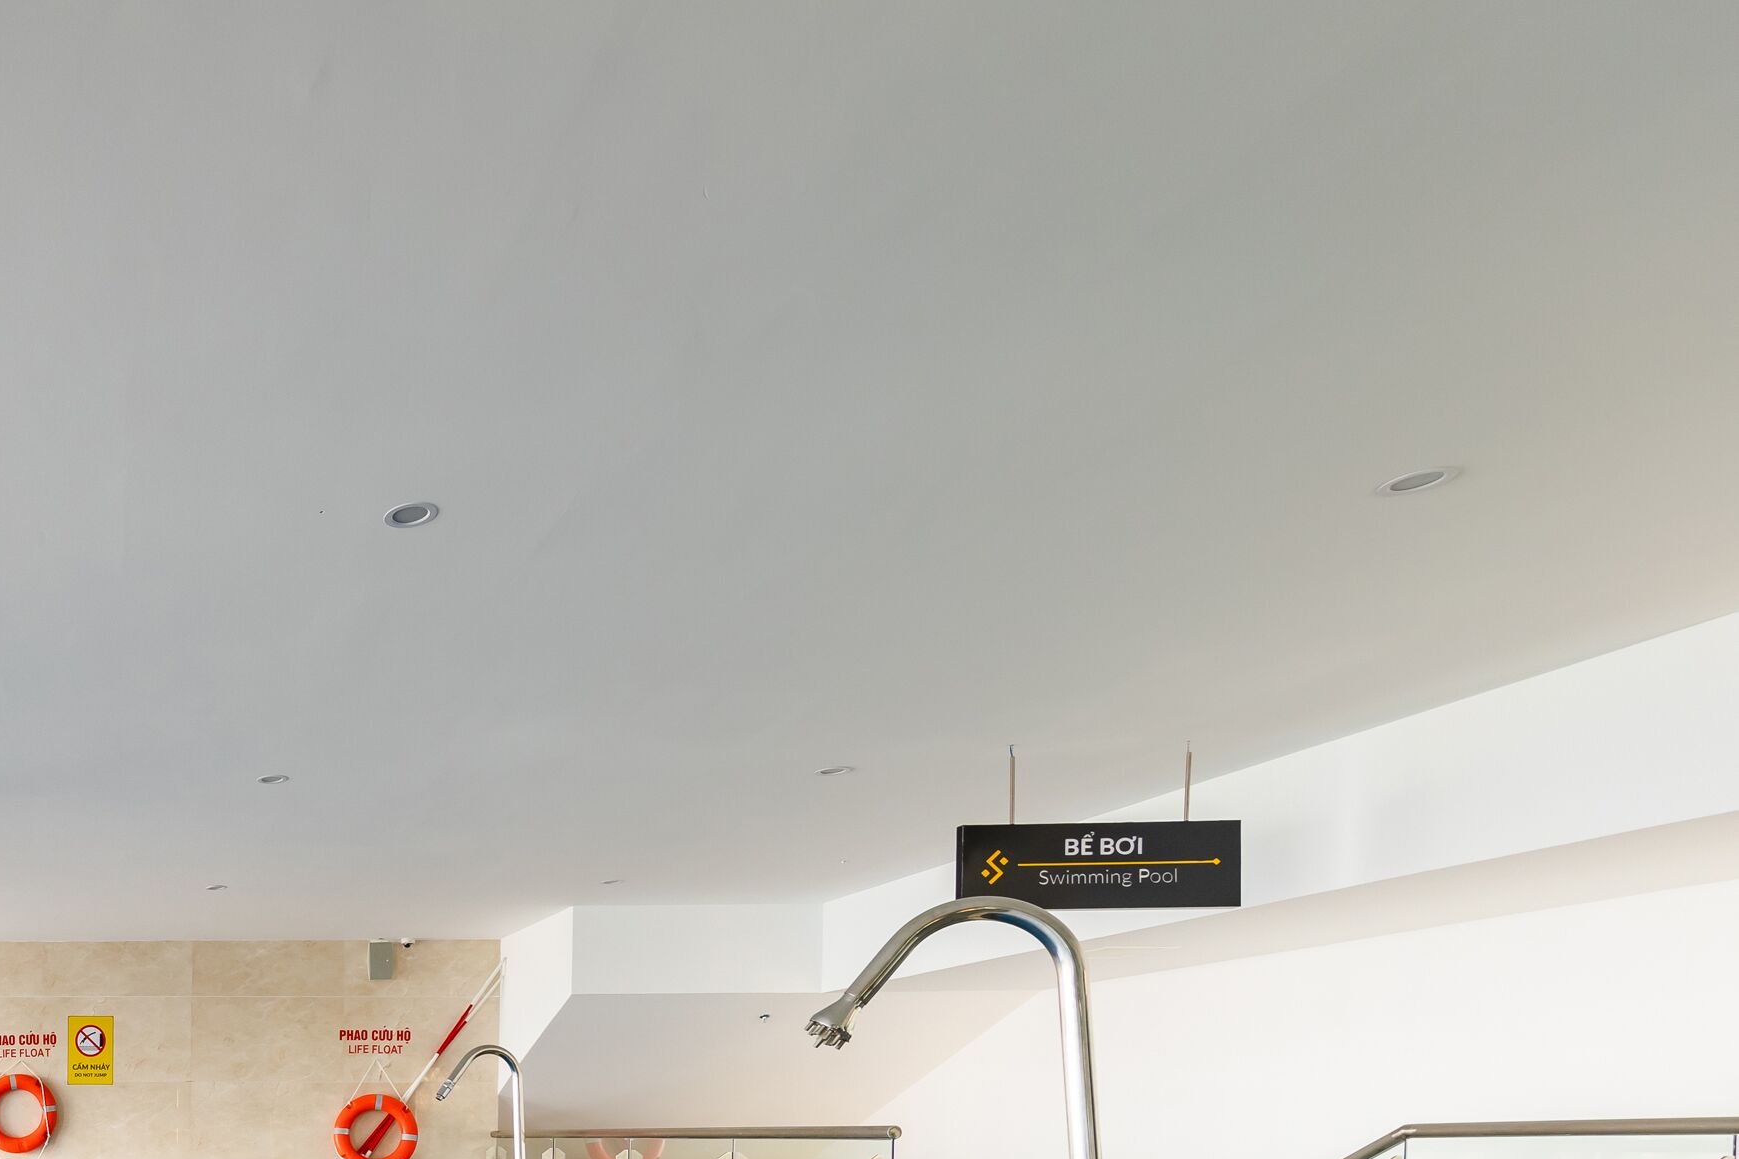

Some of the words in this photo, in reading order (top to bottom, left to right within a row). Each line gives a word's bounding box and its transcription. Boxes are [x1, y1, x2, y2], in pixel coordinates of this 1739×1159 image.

[1064, 831, 1095, 856] BỂ
[1100, 835, 1143, 855] BƠI
[1038, 868, 1132, 888] Swimming
[1138, 867, 1178, 884] Pool
[18, 1030, 40, 1045] CỨU
[43, 1031, 57, 1048] HỘ
[339, 1029, 368, 1041] PHAO
[371, 1025, 393, 1041] CỨU
[396, 1027, 411, 1045] HỘ
[20, 1048, 51, 1058] FLOAT
[348, 1045, 369, 1054] LIFE
[372, 1045, 403, 1054] FLOAT
